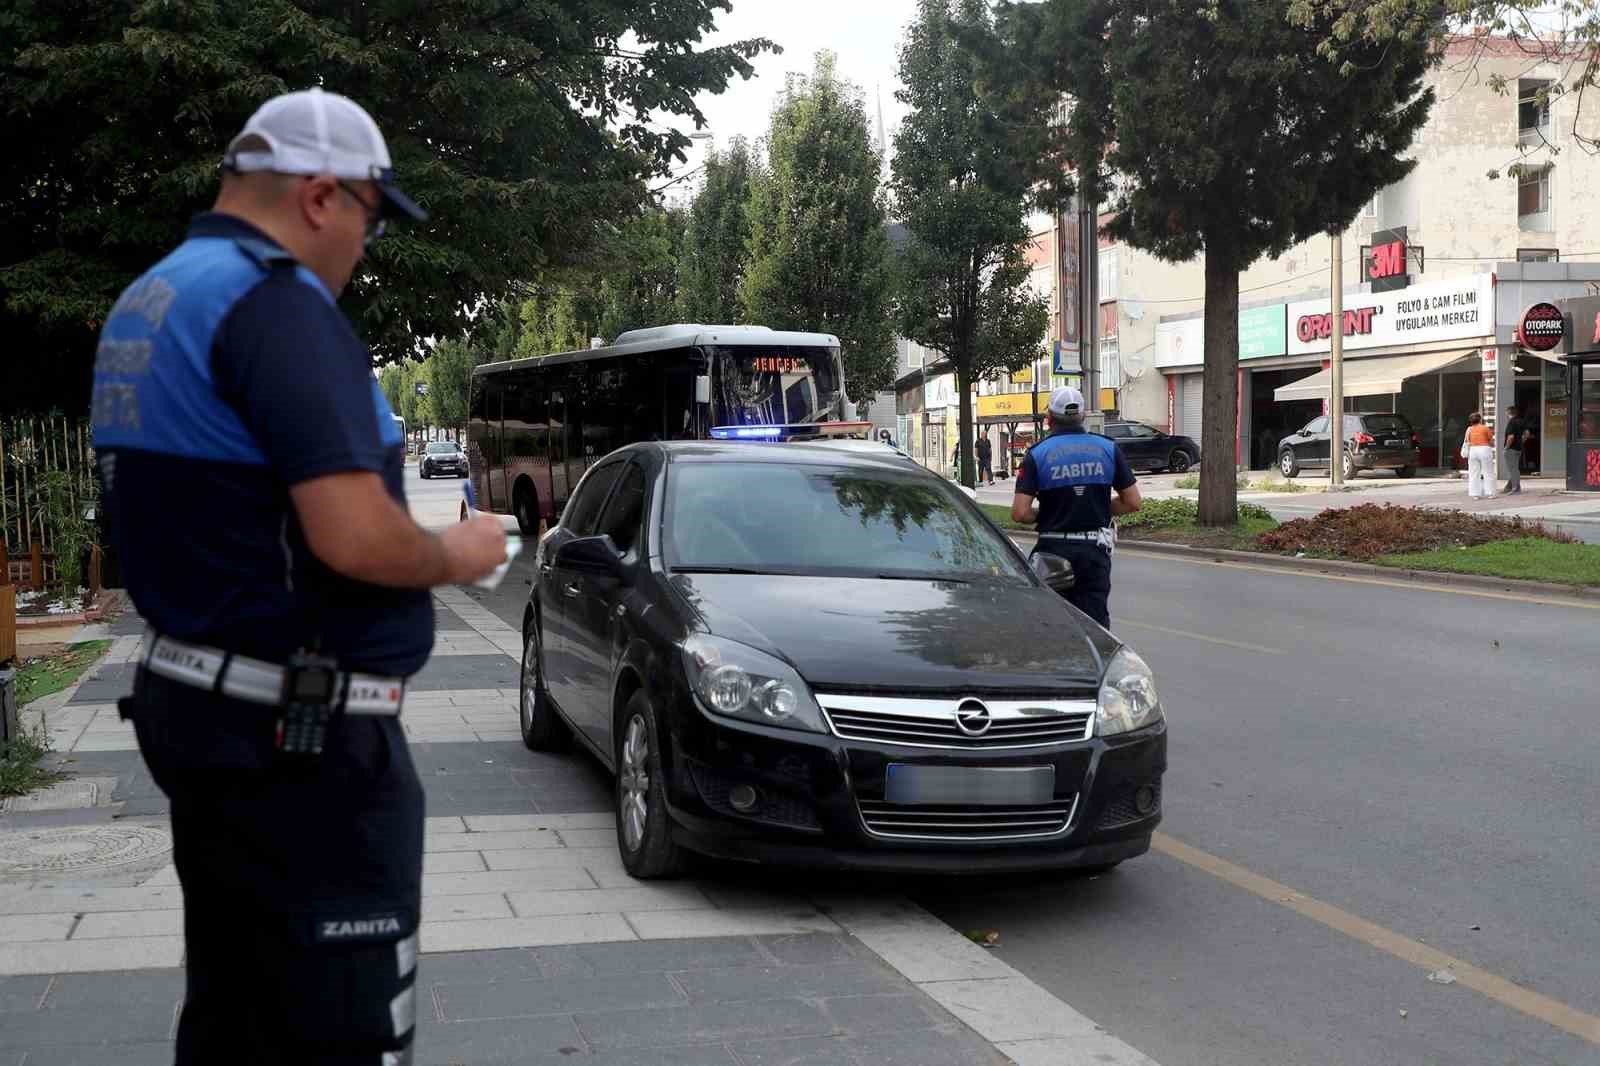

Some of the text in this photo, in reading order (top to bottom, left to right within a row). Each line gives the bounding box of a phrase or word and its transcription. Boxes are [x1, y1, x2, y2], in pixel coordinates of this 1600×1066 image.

[1369, 240, 1405, 279] 3M
[1397, 299, 1422, 314] FOLYO
[1424, 298, 1430, 310] &
[1432, 295, 1451, 309] CAM
[1396, 315, 1439, 331] UYGULAMA
[1525, 319, 1562, 330] OTOPARK
[1484, 350, 1496, 361] 3M
[1050, 462, 1105, 480] ZABITA
[322, 918, 400, 936] ZABITA
